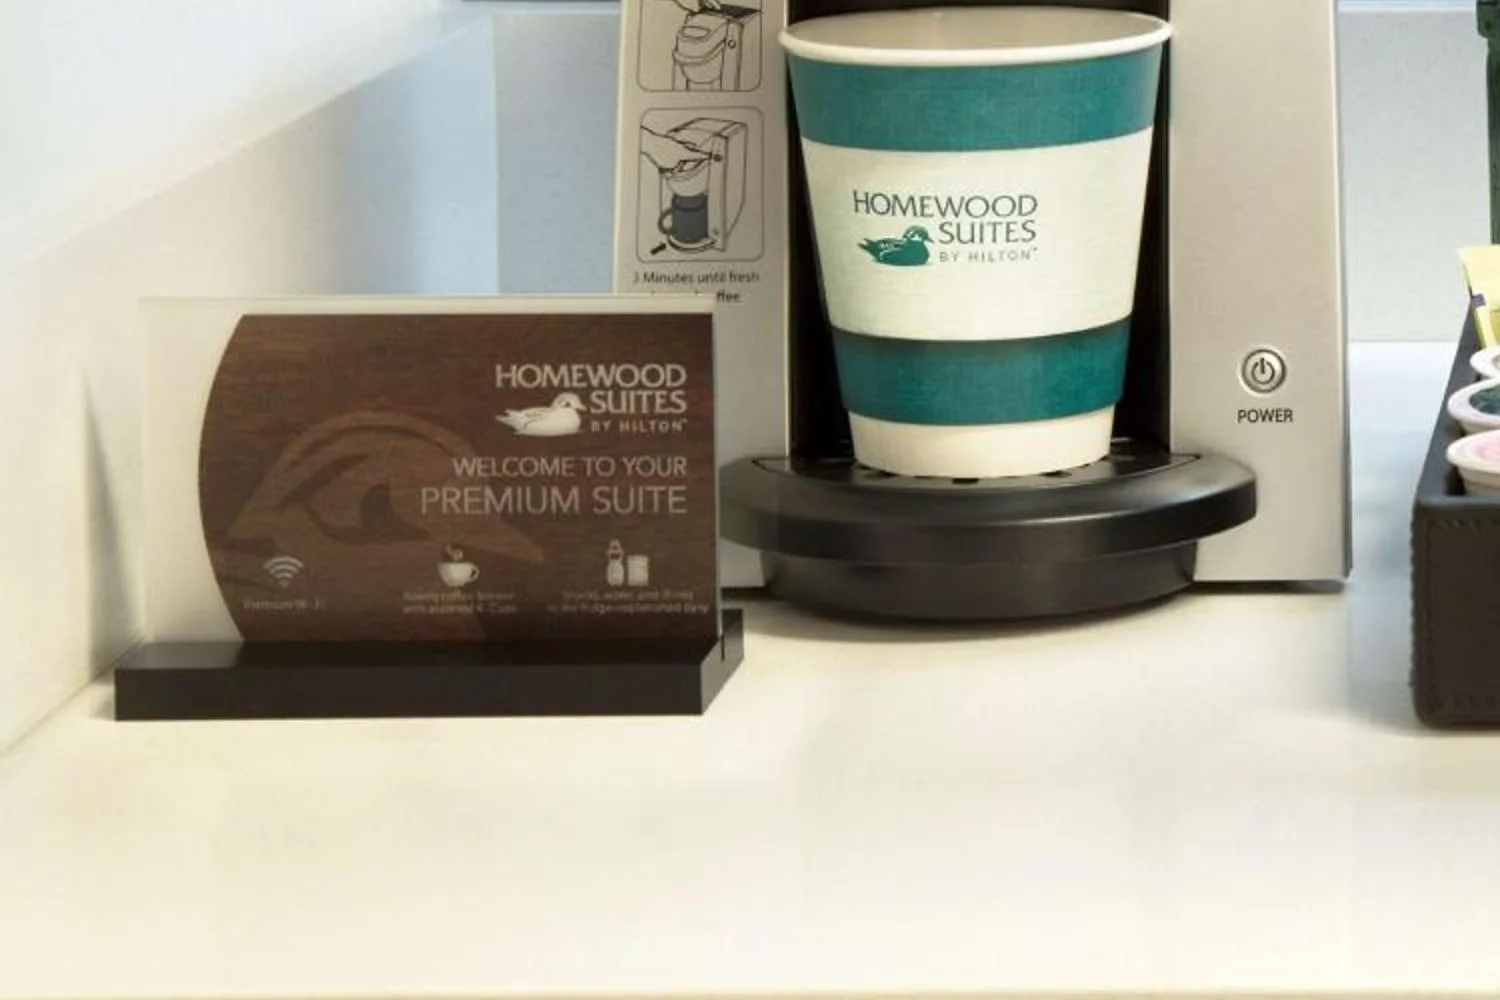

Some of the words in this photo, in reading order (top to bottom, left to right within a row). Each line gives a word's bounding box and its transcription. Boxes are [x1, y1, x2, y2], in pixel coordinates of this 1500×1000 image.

[853, 190, 1038, 218] HOMEWOOD
[939, 219, 1037, 244] SUITES
[939, 250, 960, 263] BY
[643, 271, 693, 284] Minutes
[697, 271, 726, 284] until
[729, 270, 760, 283] fresh
[495, 363, 688, 388] HOMEWOOD
[590, 389, 687, 415] SUITES
[590, 419, 610, 433] BY
[1237, 407, 1294, 424] POWER
[452, 456, 575, 478] WELCOME
[582, 456, 616, 478] TO
[622, 456, 687, 478] YOUR
[420, 487, 580, 516] PREMIUM
[592, 486, 687, 514] SUITE
